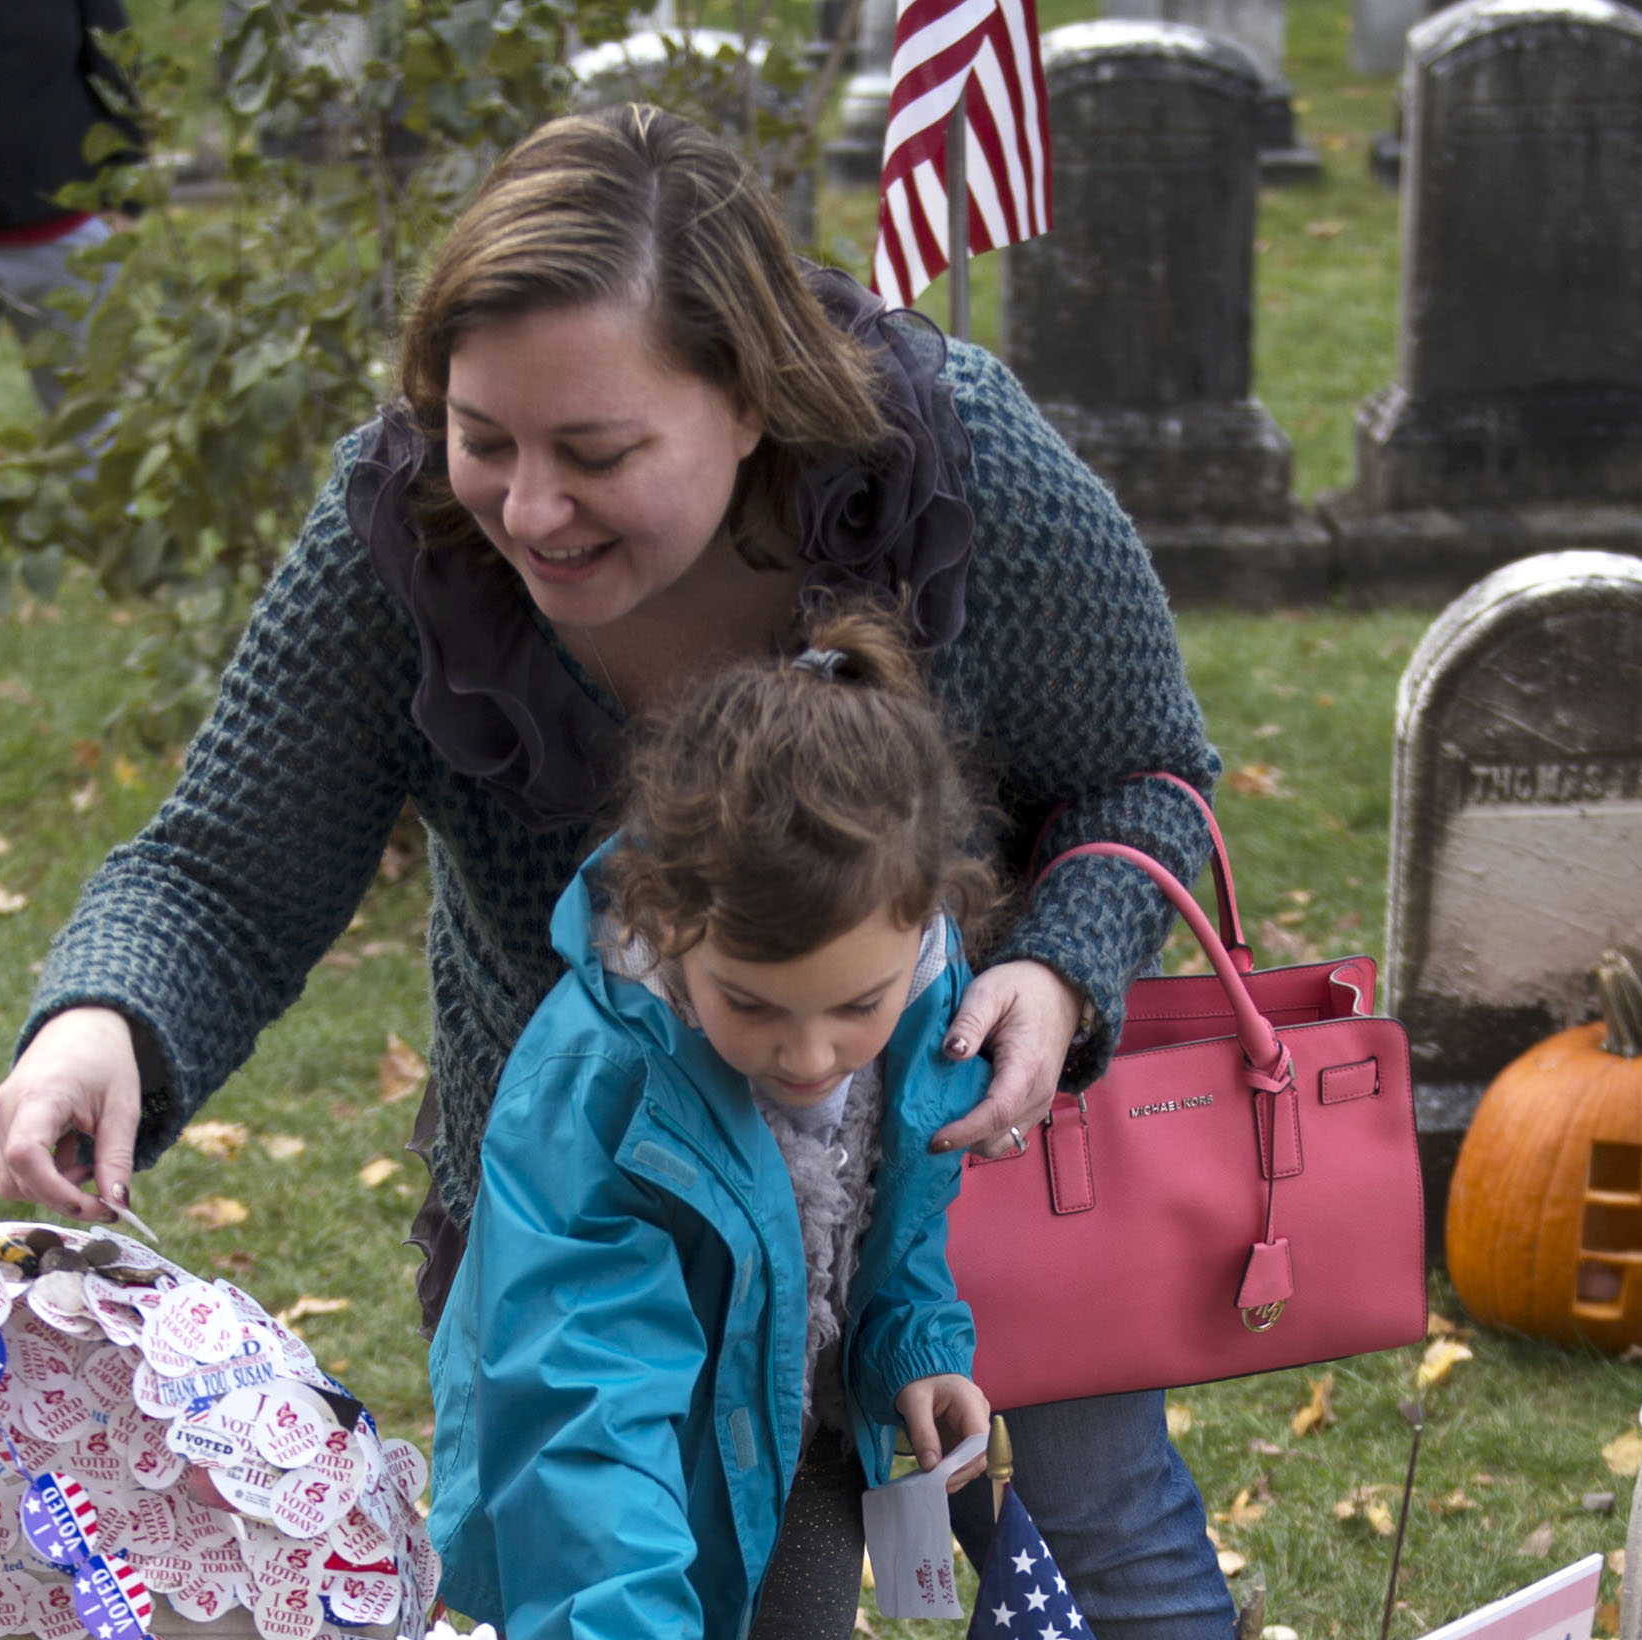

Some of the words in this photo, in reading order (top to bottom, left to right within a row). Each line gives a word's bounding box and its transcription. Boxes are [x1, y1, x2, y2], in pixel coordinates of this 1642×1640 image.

[1469, 763, 1606, 802] THOMAS
[1130, 1100, 1181, 1118] MICHAEL
[1182, 1094, 1215, 1109] KORS
[160, 1376, 198, 1405] THANK
[236, 1360, 278, 1390] SUSAN!
[175, 1430, 183, 1441] I
[184, 1433, 235, 1456] VOTED
[265, 1422, 277, 1438] I
[268, 1422, 316, 1452] VOTED
[276, 1433, 321, 1465] TODAY!
[33, 1522, 52, 1536] I
[41, 1485, 83, 1553] VOTED
[83, 1603, 102, 1617] I
[90, 1567, 135, 1634] VOTED
